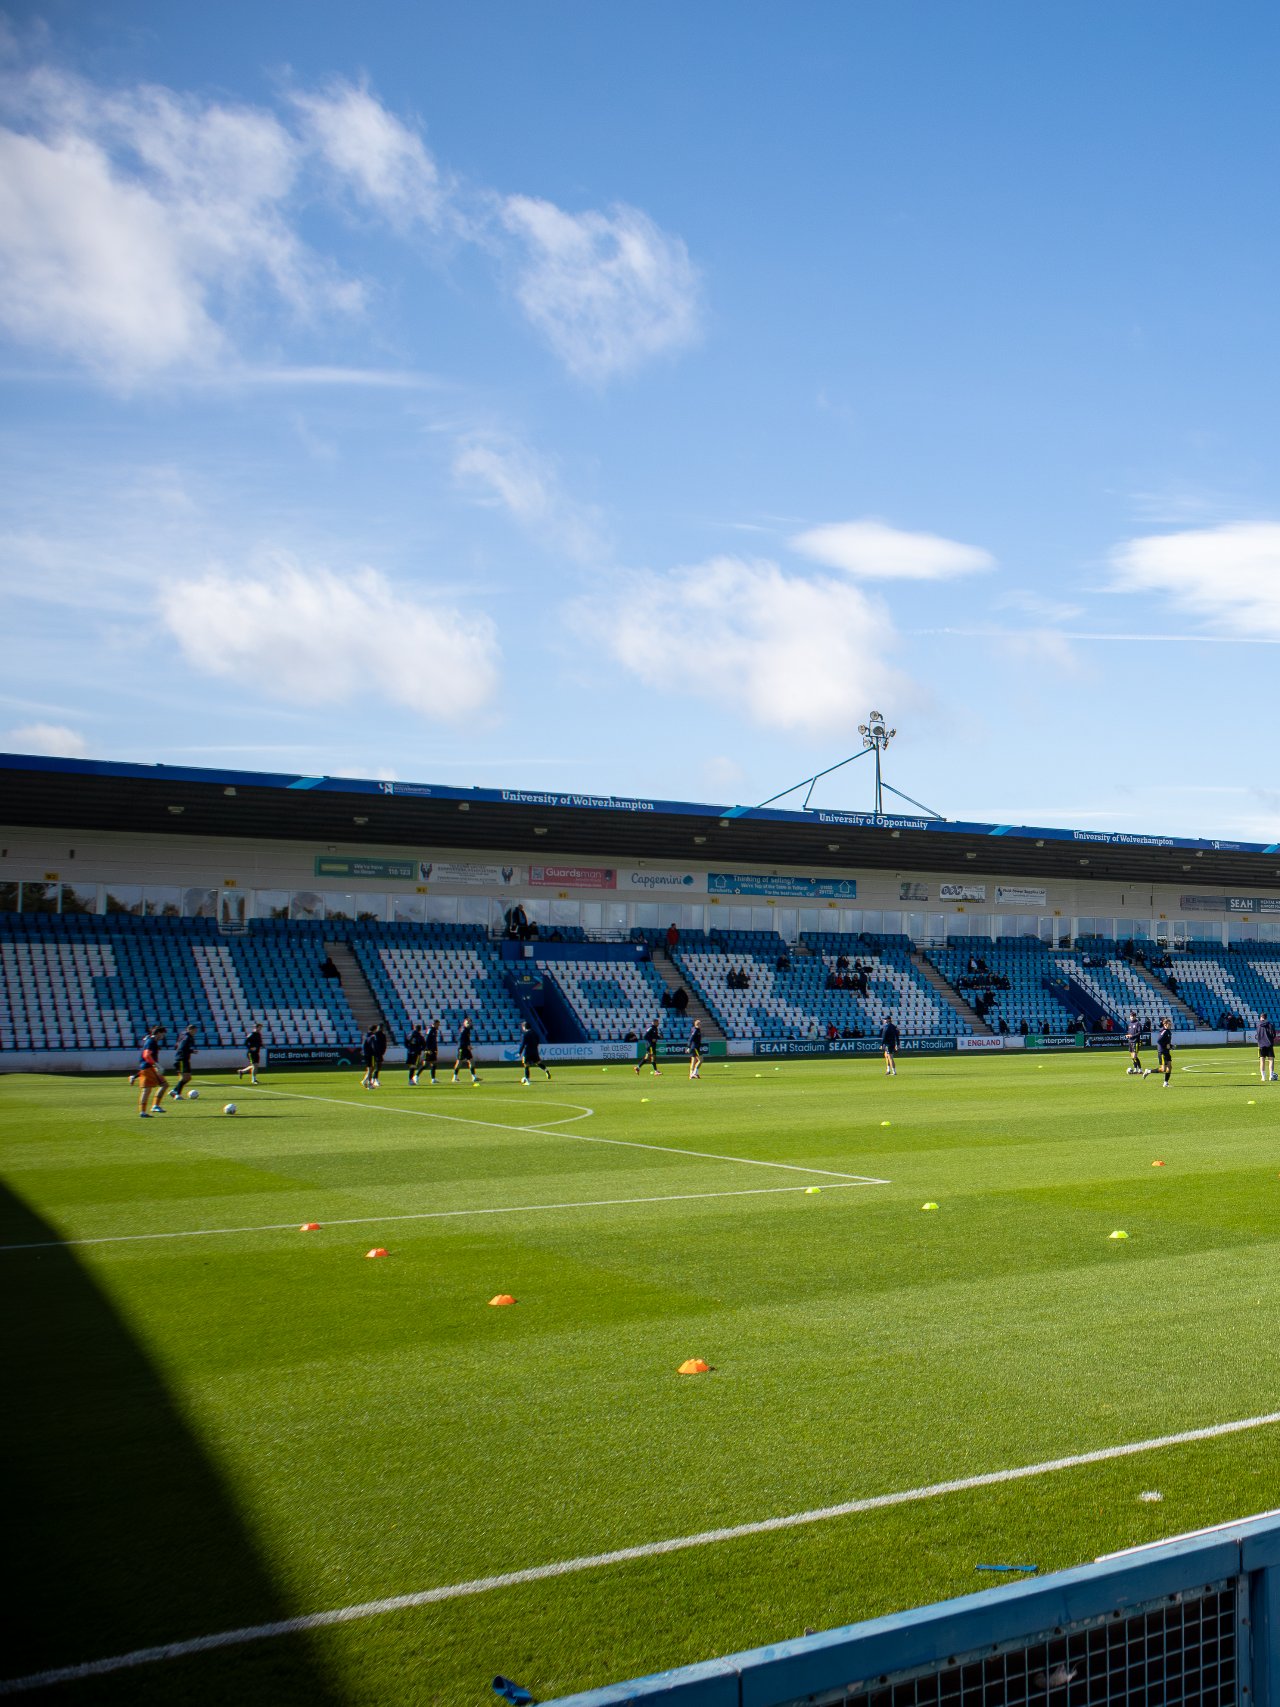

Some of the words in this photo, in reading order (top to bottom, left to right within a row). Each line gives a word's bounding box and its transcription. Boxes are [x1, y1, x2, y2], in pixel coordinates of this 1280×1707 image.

[502, 790, 558, 806] University
[560, 796, 572, 804] of
[572, 796, 654, 811] Wolverhampton
[820, 814, 864, 826] University
[866, 816, 875, 824] of
[876, 817, 929, 830] Opportunity
[1074, 832, 1110, 842] University
[1120, 836, 1174, 846] Wolverhampton
[546, 868, 602, 878] Guardsman
[632, 872, 682, 888] Capgemini
[734, 876, 761, 884] Thinking
[771, 878, 795, 886] selling?
[1230, 899, 1253, 908] SEAH
[760, 1044, 787, 1052] SEAH
[790, 1042, 826, 1052] Stadium
[829, 1042, 854, 1051] SEAH
[899, 1040, 918, 1048] EAH
[921, 1038, 954, 1048] Stadium
[1036, 1038, 1076, 1046] enterprise
[550, 1044, 594, 1056] couriers
